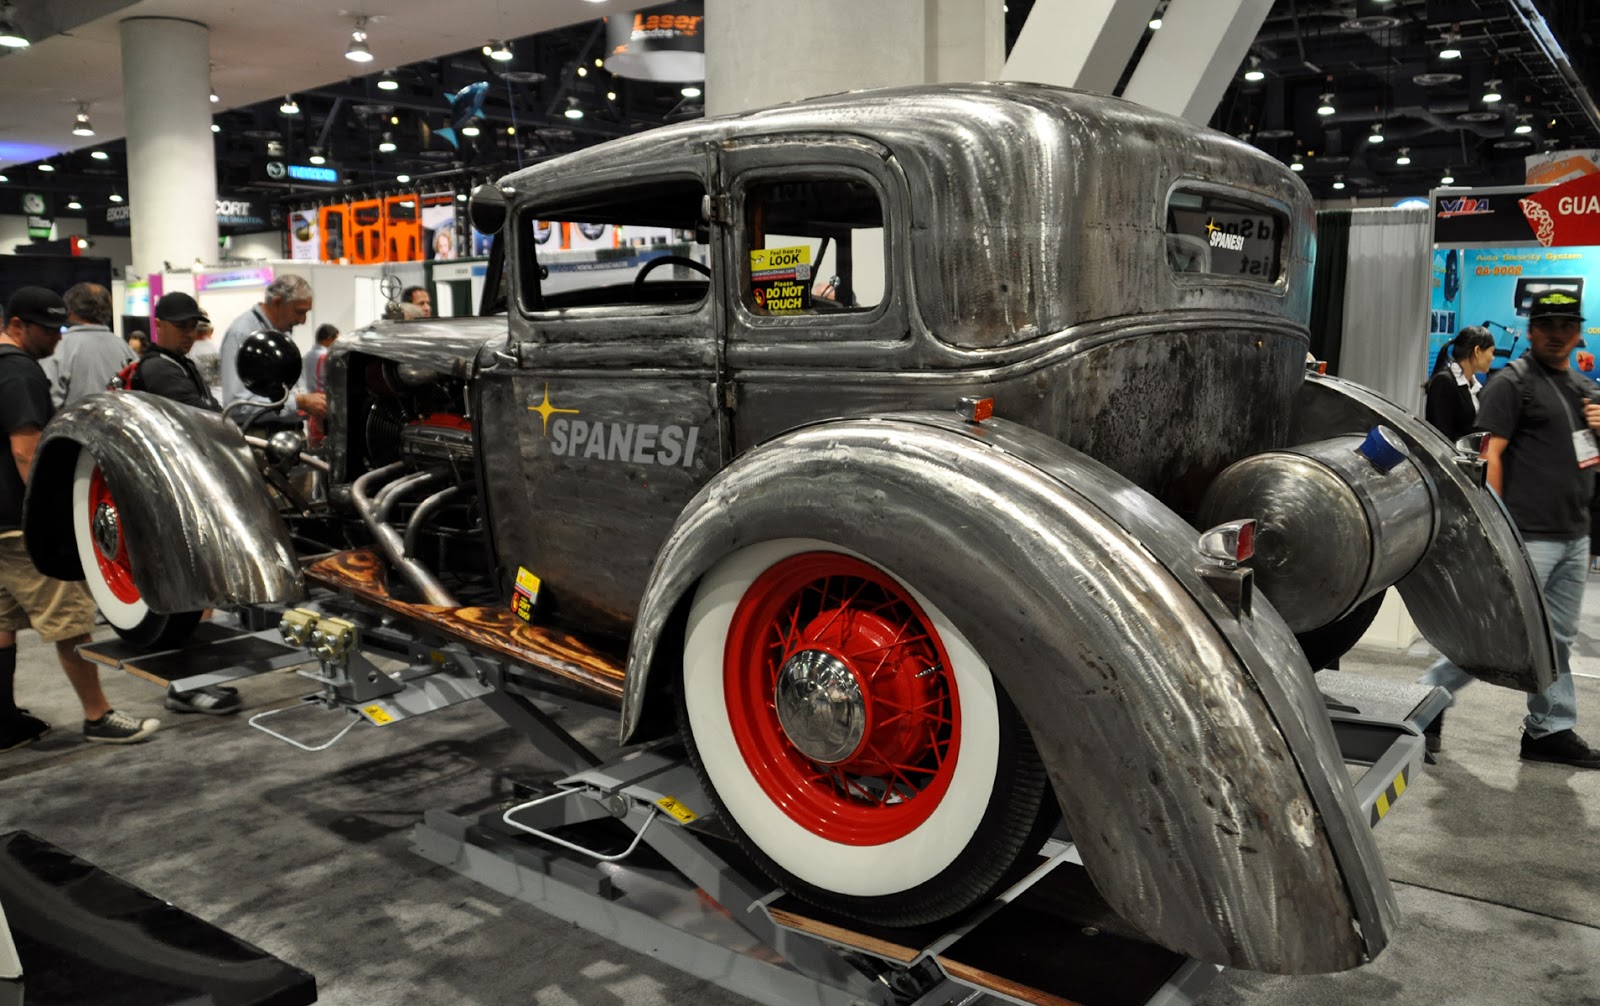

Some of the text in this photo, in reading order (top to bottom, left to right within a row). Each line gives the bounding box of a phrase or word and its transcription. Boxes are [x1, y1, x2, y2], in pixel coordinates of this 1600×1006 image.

[633, 13, 702, 31] Laser
[106, 205, 130, 222] ESCOR
[1209, 230, 1245, 251] SPANESI
[769, 253, 800, 266] LOOK
[1545, 253, 1583, 262] System
[766, 286, 804, 299] DO NOT
[767, 298, 802, 310] TOUCH
[551, 418, 699, 467] SPANESI
